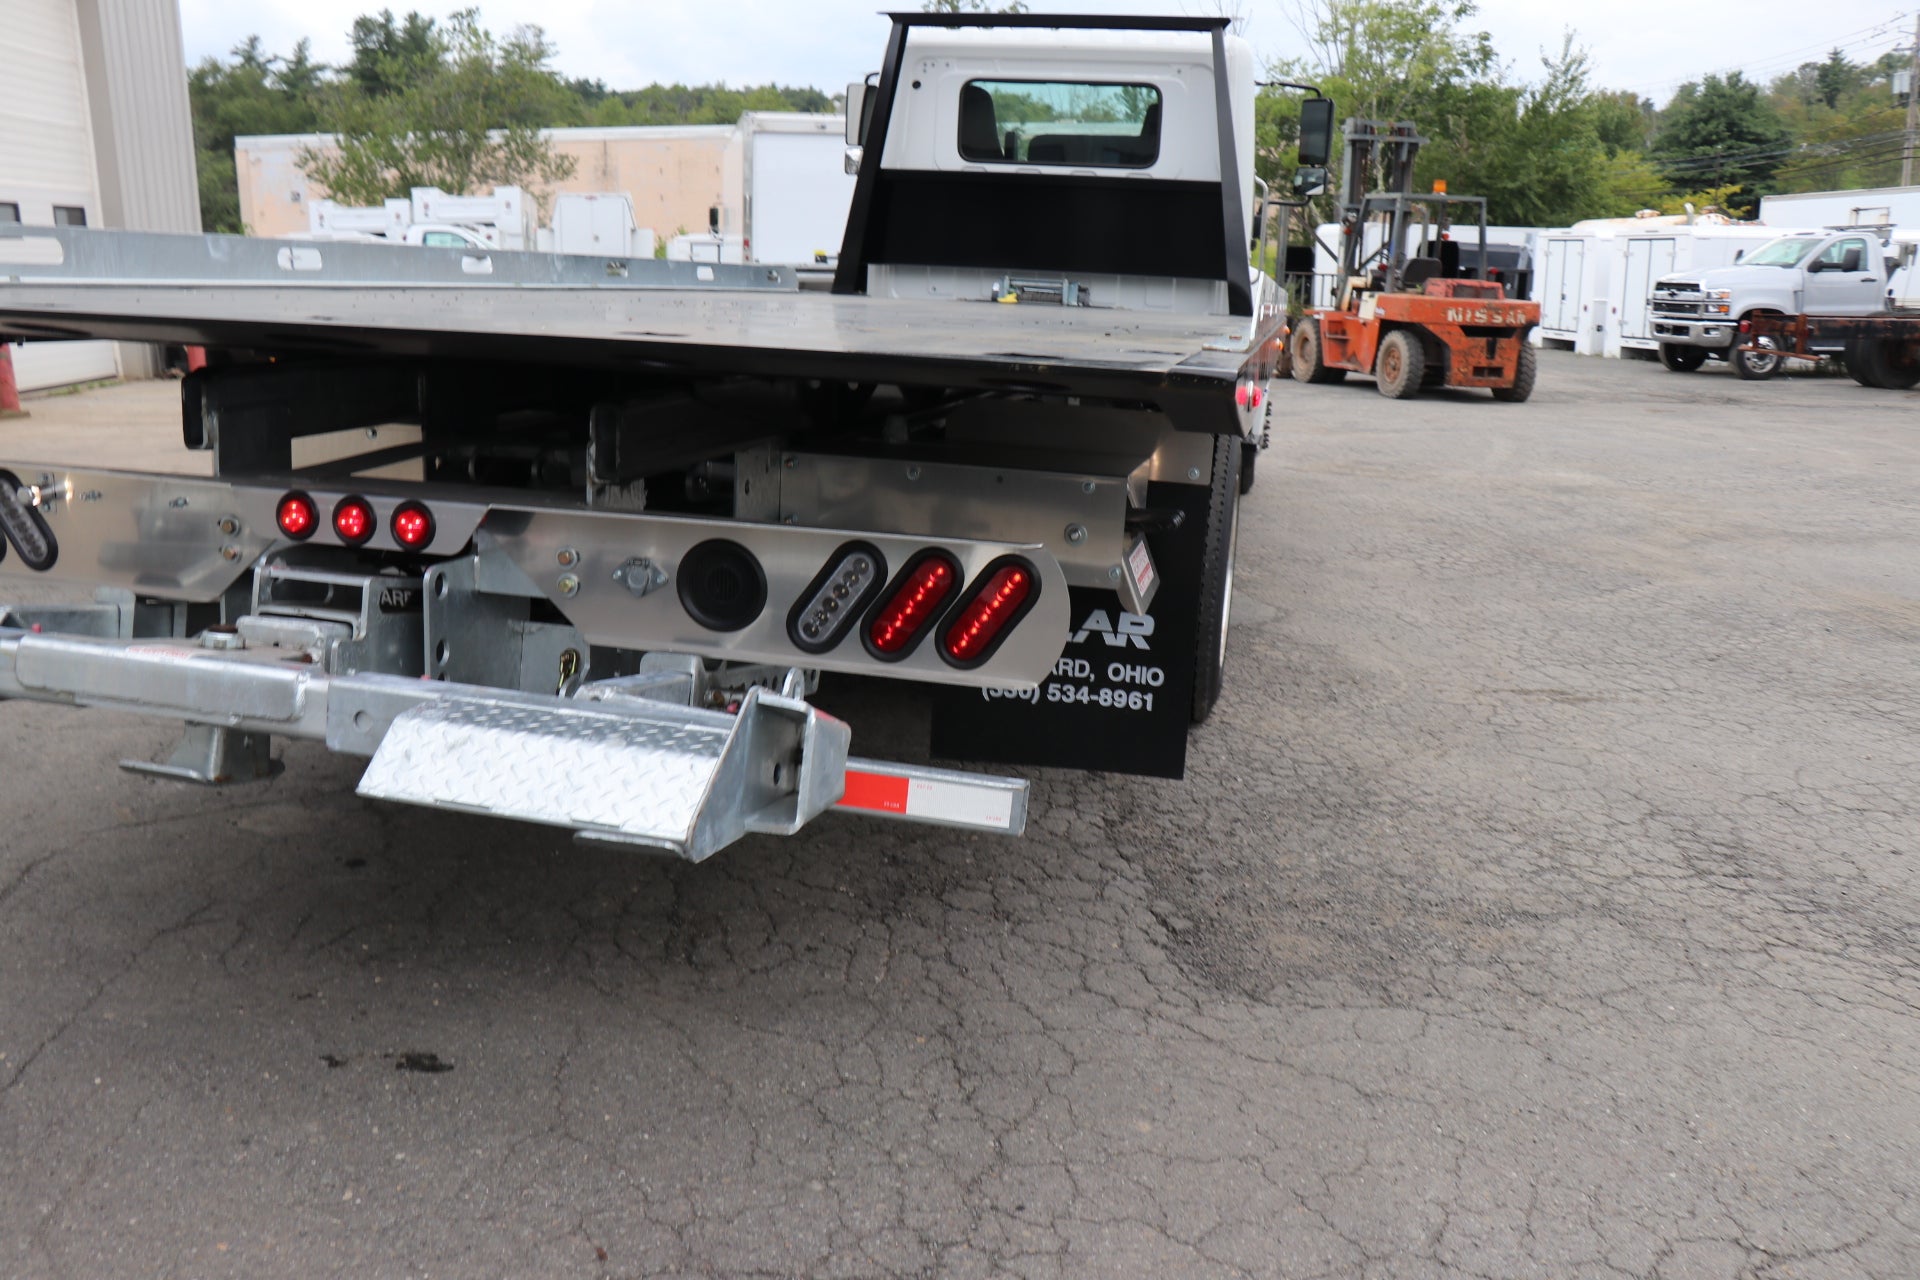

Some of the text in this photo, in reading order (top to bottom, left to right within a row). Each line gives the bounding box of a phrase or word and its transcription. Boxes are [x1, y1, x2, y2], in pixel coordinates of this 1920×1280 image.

[1447, 307, 1526, 325] NISSAN
[1066, 609, 1155, 650] AR
[1107, 662, 1165, 687] OHIO
[1046, 682, 1153, 712] 534-8961
